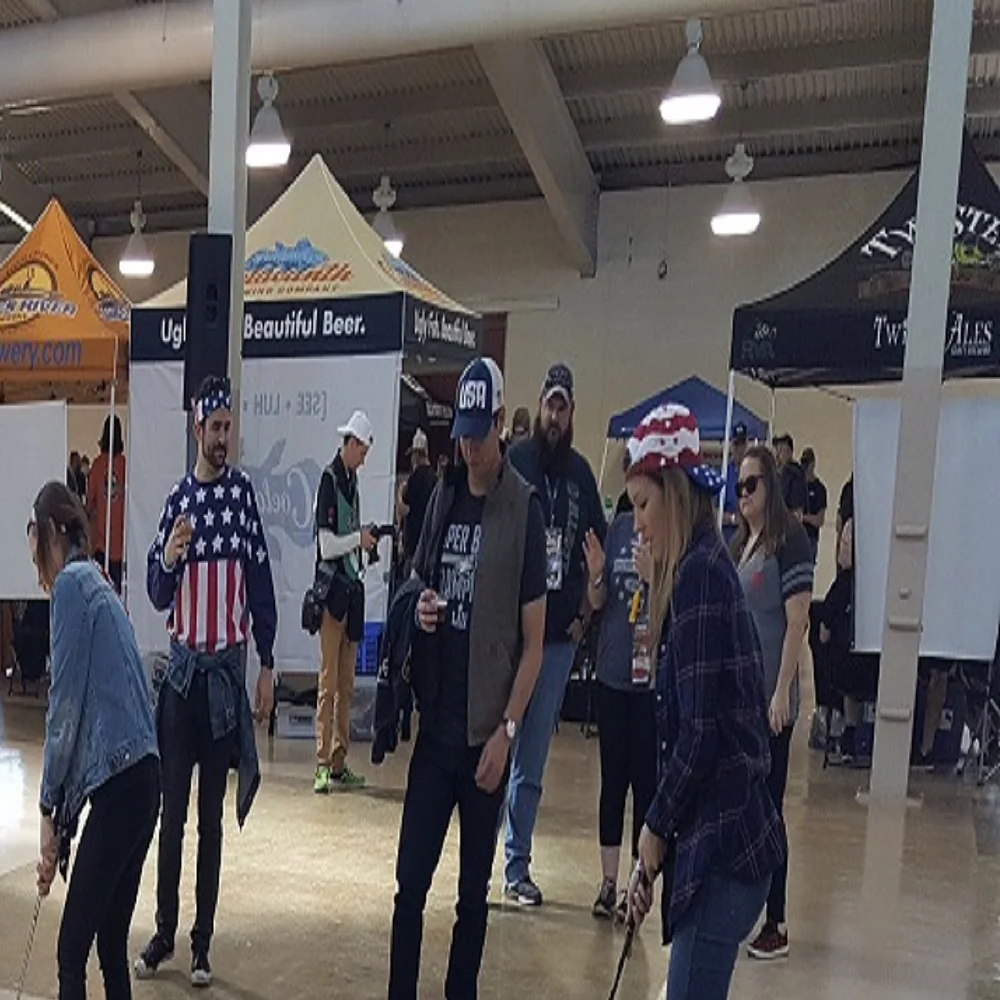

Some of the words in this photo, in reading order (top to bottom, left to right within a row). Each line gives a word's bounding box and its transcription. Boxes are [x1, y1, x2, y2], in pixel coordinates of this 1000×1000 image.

[160, 315, 187, 350] Ugl
[244, 308, 317, 341] Beautiful
[323, 309, 367, 336] Beer.
[459, 380, 486, 409] USA
[445, 523, 470, 553] PER
